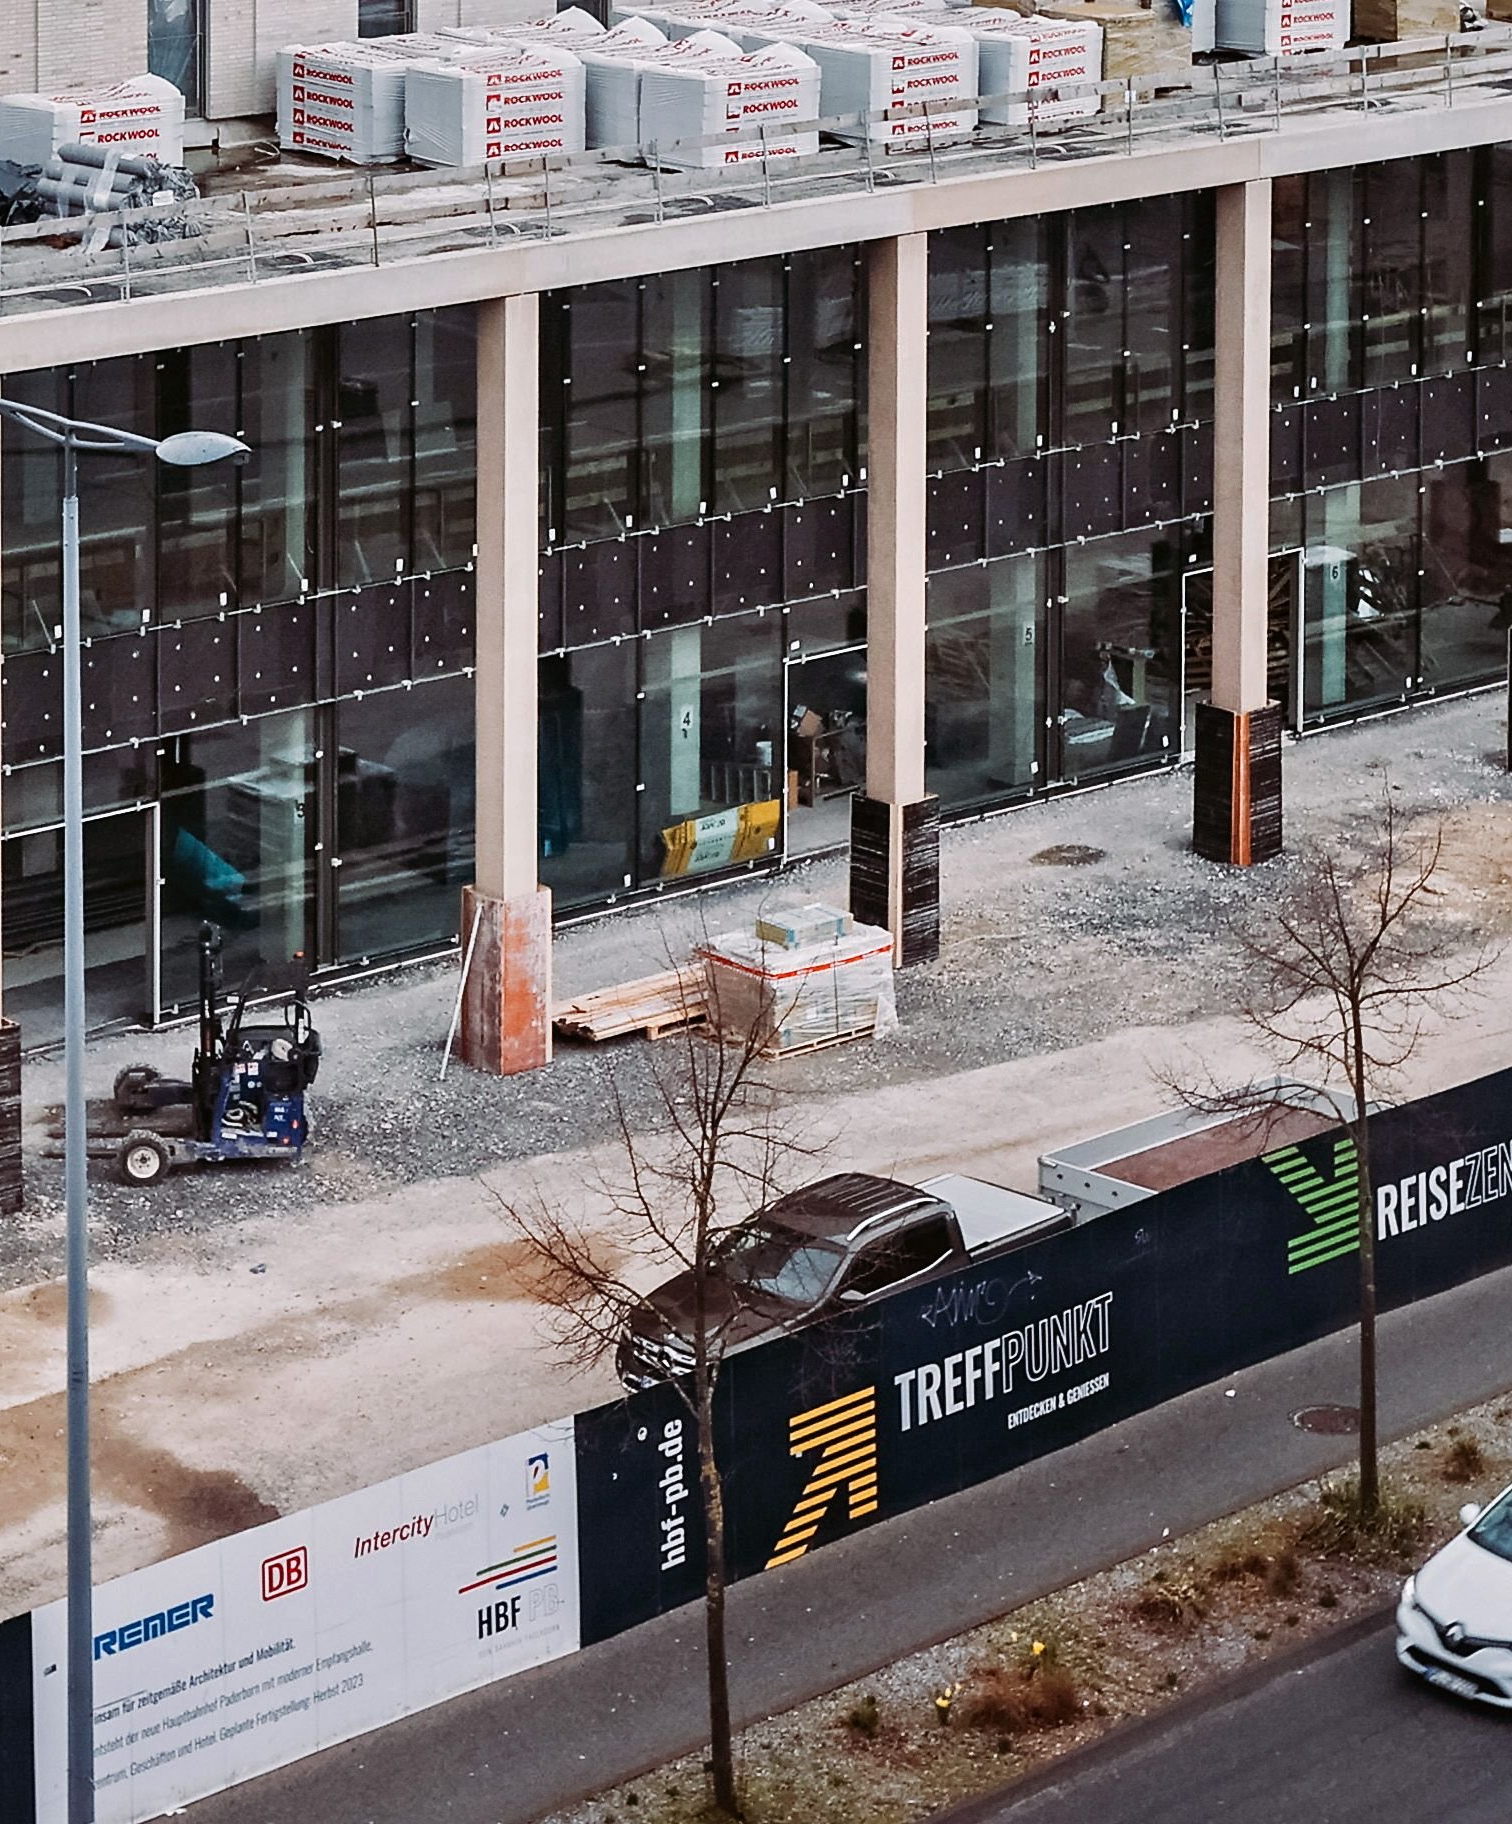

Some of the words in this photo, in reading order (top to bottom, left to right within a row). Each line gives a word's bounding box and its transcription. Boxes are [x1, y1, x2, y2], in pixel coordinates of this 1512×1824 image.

[908, 52, 959, 66] ROCKWOOL
[306, 69, 354, 85] ROCKWOOL
[504, 70, 563, 84] ROCKWOOL
[744, 78, 800, 91] ROCKWOOL
[907, 75, 959, 88] ROCKWOOL
[306, 92, 354, 109] ROCKWOOL
[504, 92, 563, 105] ROCKWOOL
[743, 99, 798, 114] ROCKWOOL
[99, 106, 161, 119] ROCKWOOL
[306, 114, 354, 132] ROCKWOOL
[504, 114, 563, 129] ROCKWOOL
[97, 129, 160, 143] ROCKWOOL
[504, 139, 563, 153] ROCKWOOL
[683, 711, 691, 726] 4
[894, 1291, 1113, 1432] TREFFPUNKT
[1008, 1395, 1057, 1430] ENTDECKEN
[1058, 1391, 1066, 1409] &
[1066, 1372, 1110, 1405] GENIESSEN
[658, 1419, 689, 1570] hbf-pb.de
[268, 1556, 302, 1593] DB
[478, 1595, 521, 1640] HBF
[93, 1593, 214, 1661] REMER
[137, 1680, 187, 1710] zeitgemäße
[189, 1660, 236, 1689] Architektur
[239, 1651, 254, 1669] und
[163, 1698, 218, 1730] Hauptbahnhof
[219, 1683, 260, 1709] Paderborn
[262, 1677, 275, 1693] mit
[177, 1740, 193, 1758] und
[219, 1717, 255, 1742] Geplante
[313, 1684, 339, 1704] Herbst
[341, 1673, 364, 1694] 2023
